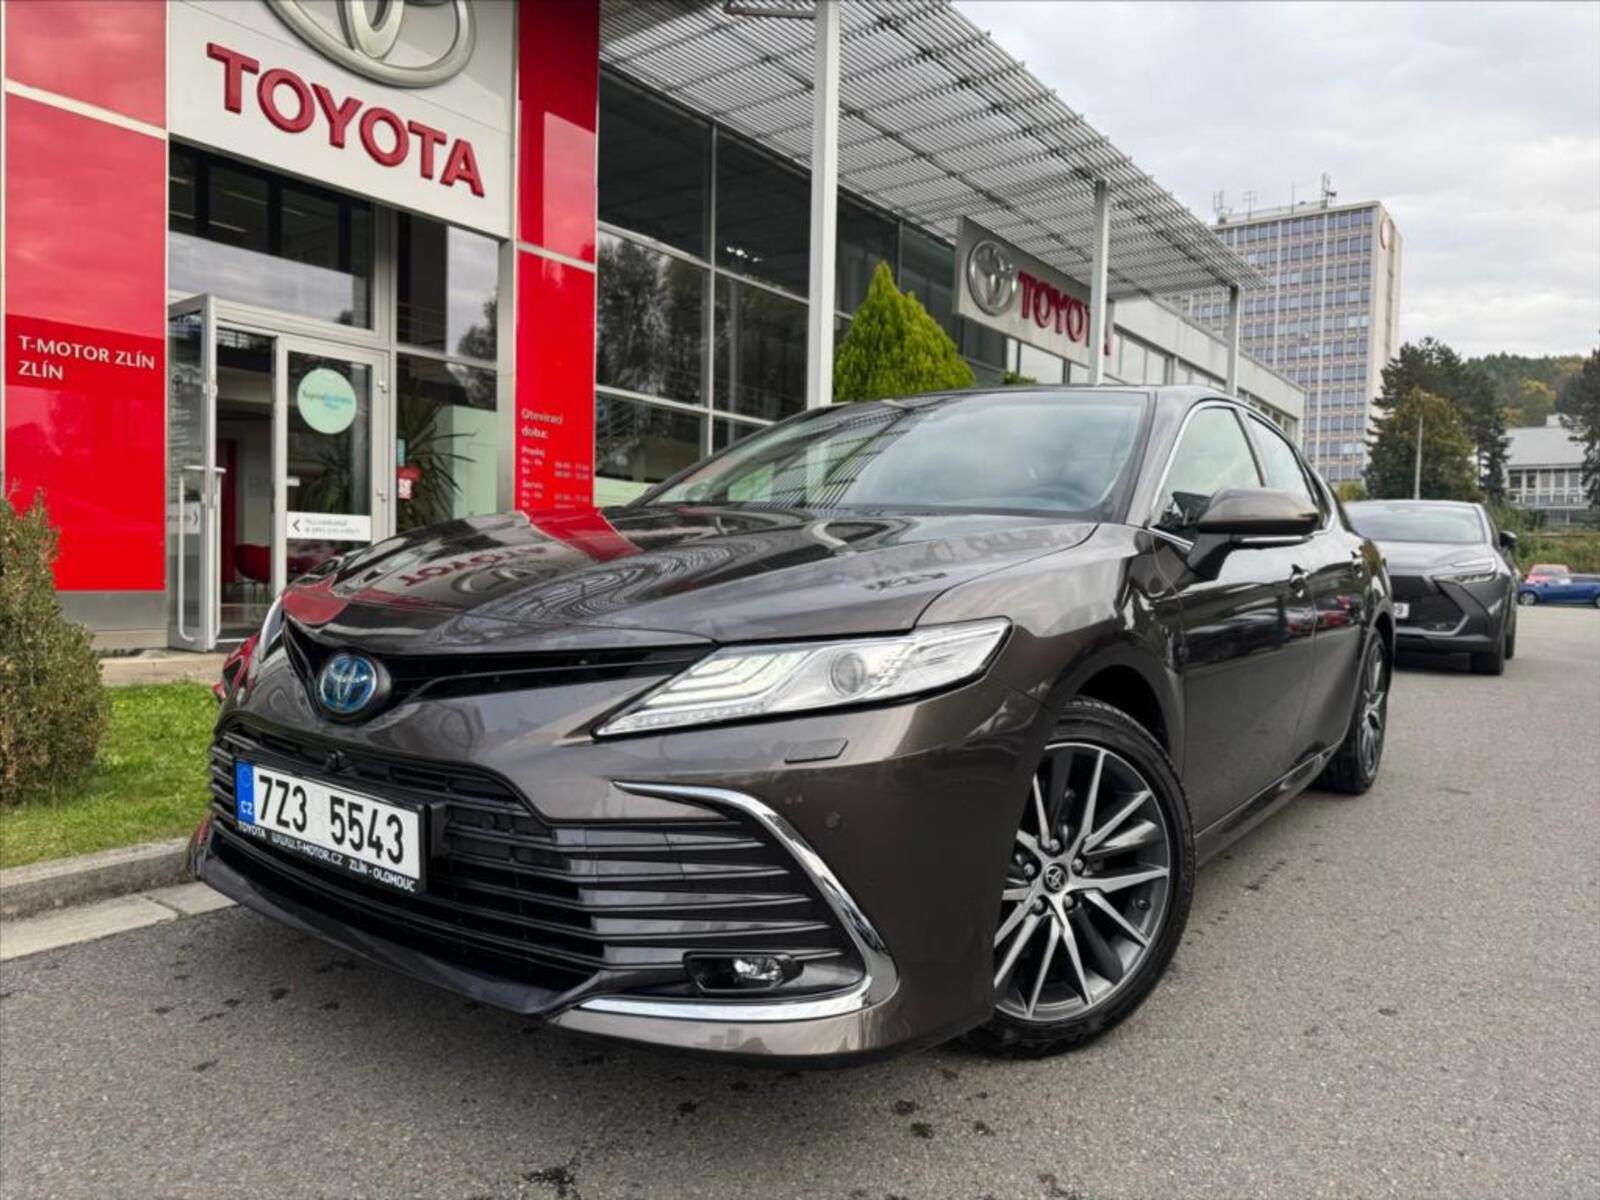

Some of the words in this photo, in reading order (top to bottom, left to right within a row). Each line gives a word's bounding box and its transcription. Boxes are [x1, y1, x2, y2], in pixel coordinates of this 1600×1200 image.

[206, 42, 485, 198] TOYOTA
[1018, 271, 1110, 356] TOYO
[18, 335, 109, 363] T-MOTOR
[115, 350, 155, 369] ZLÍN
[18, 360, 63, 380] ZLÍN
[240, 800, 253, 815] CZ
[259, 775, 307, 833] 7Z3
[329, 795, 404, 865] 5543
[373, 867, 416, 893] OLOMOUC
